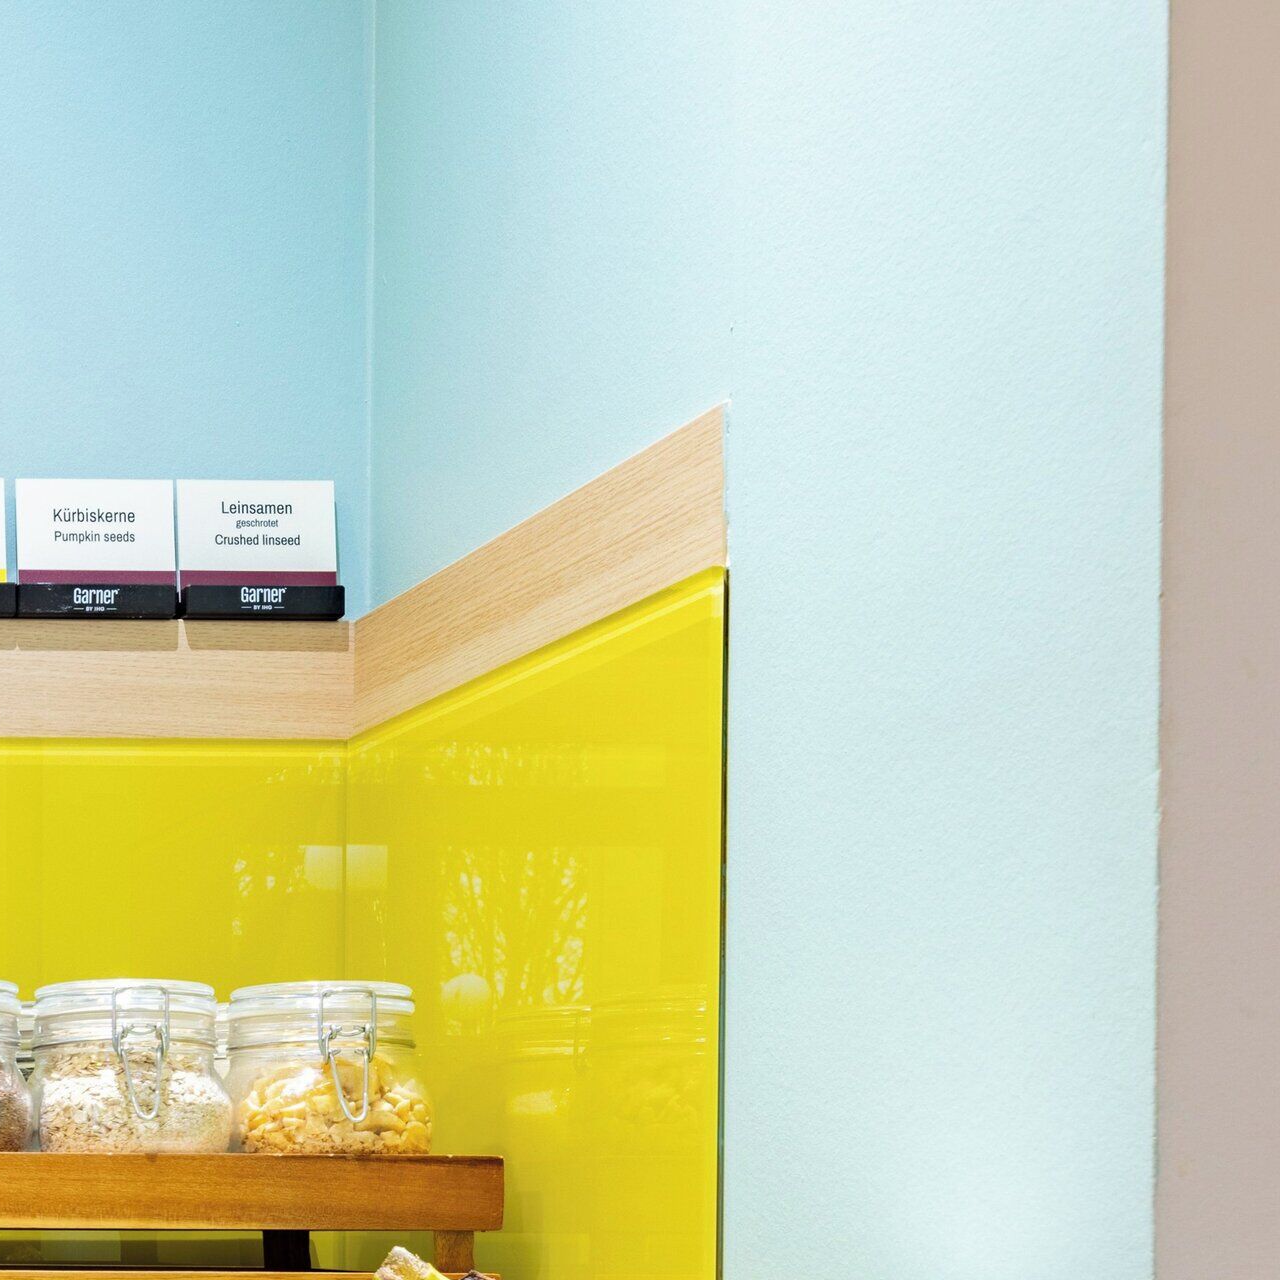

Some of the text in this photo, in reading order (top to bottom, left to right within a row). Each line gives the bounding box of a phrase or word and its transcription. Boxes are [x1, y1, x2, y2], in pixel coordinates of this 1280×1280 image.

[221, 501, 293, 514] Leinsamen
[53, 508, 136, 523] Kürbiskerne
[236, 519, 279, 529] geschrotet
[54, 531, 136, 544] Pumpkin seeds
[215, 534, 301, 545] Crushed linseed
